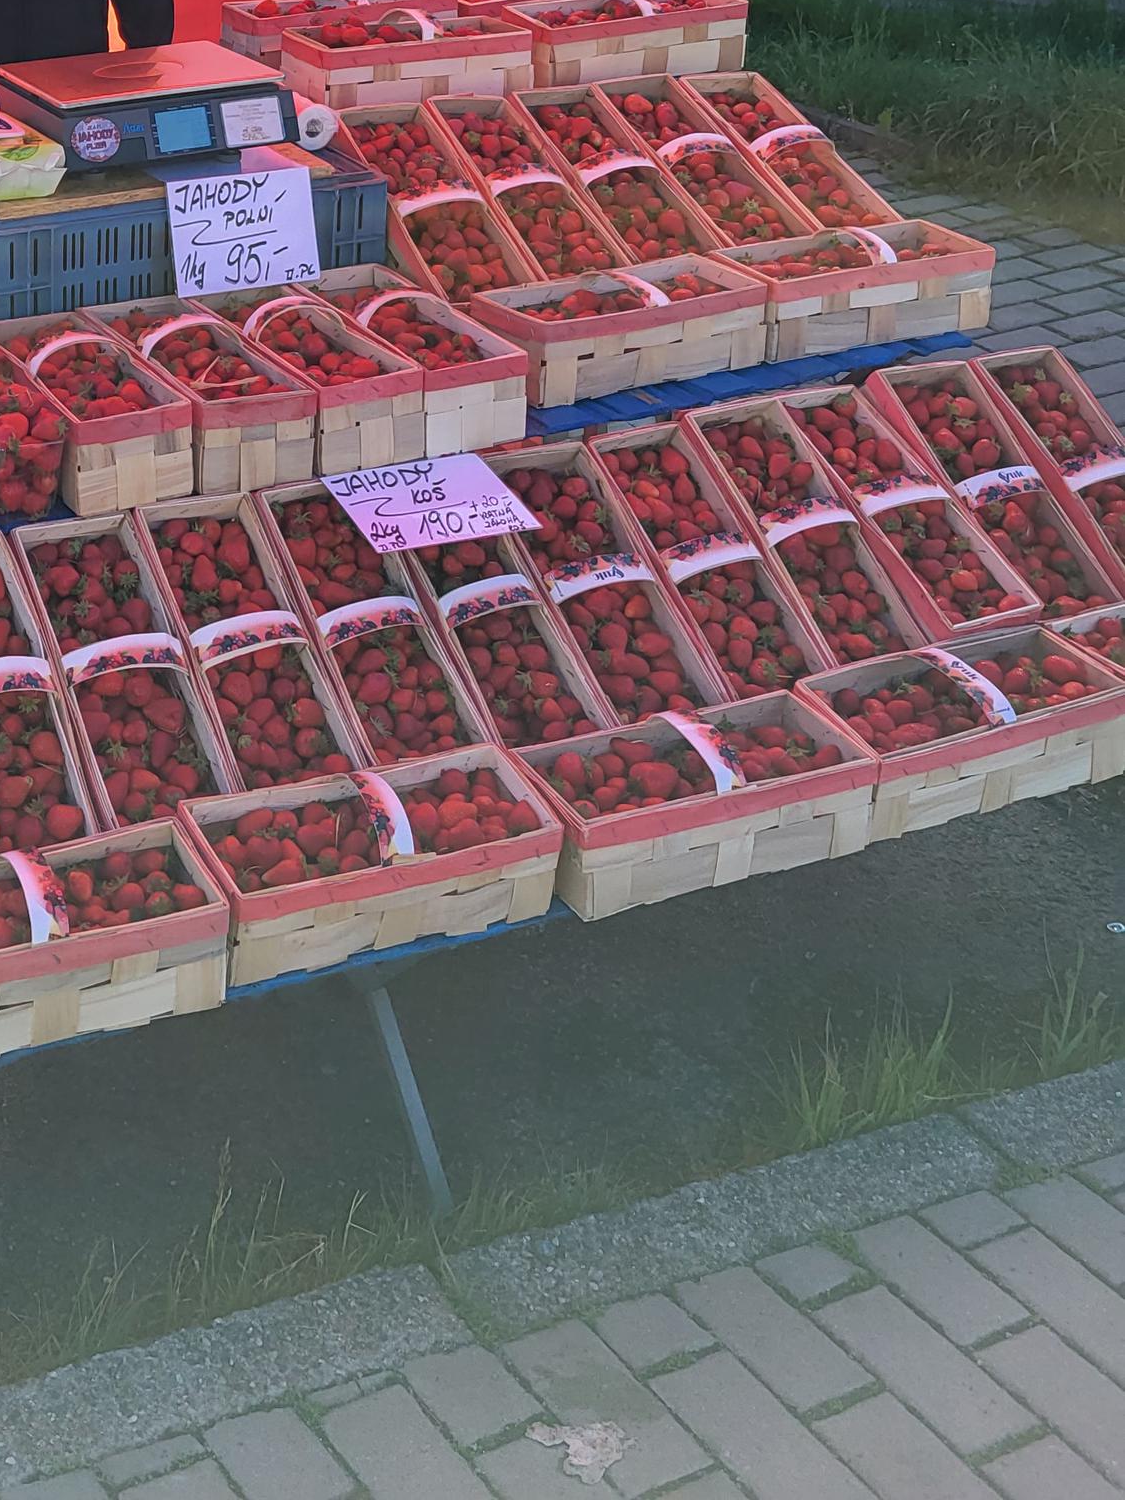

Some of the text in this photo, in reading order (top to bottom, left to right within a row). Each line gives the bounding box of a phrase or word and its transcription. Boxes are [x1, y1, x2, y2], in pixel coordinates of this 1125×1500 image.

[174, 173, 269, 214] JAHODY
[180, 250, 206, 290] 1kg
[331, 463, 434, 497] JAHODY
